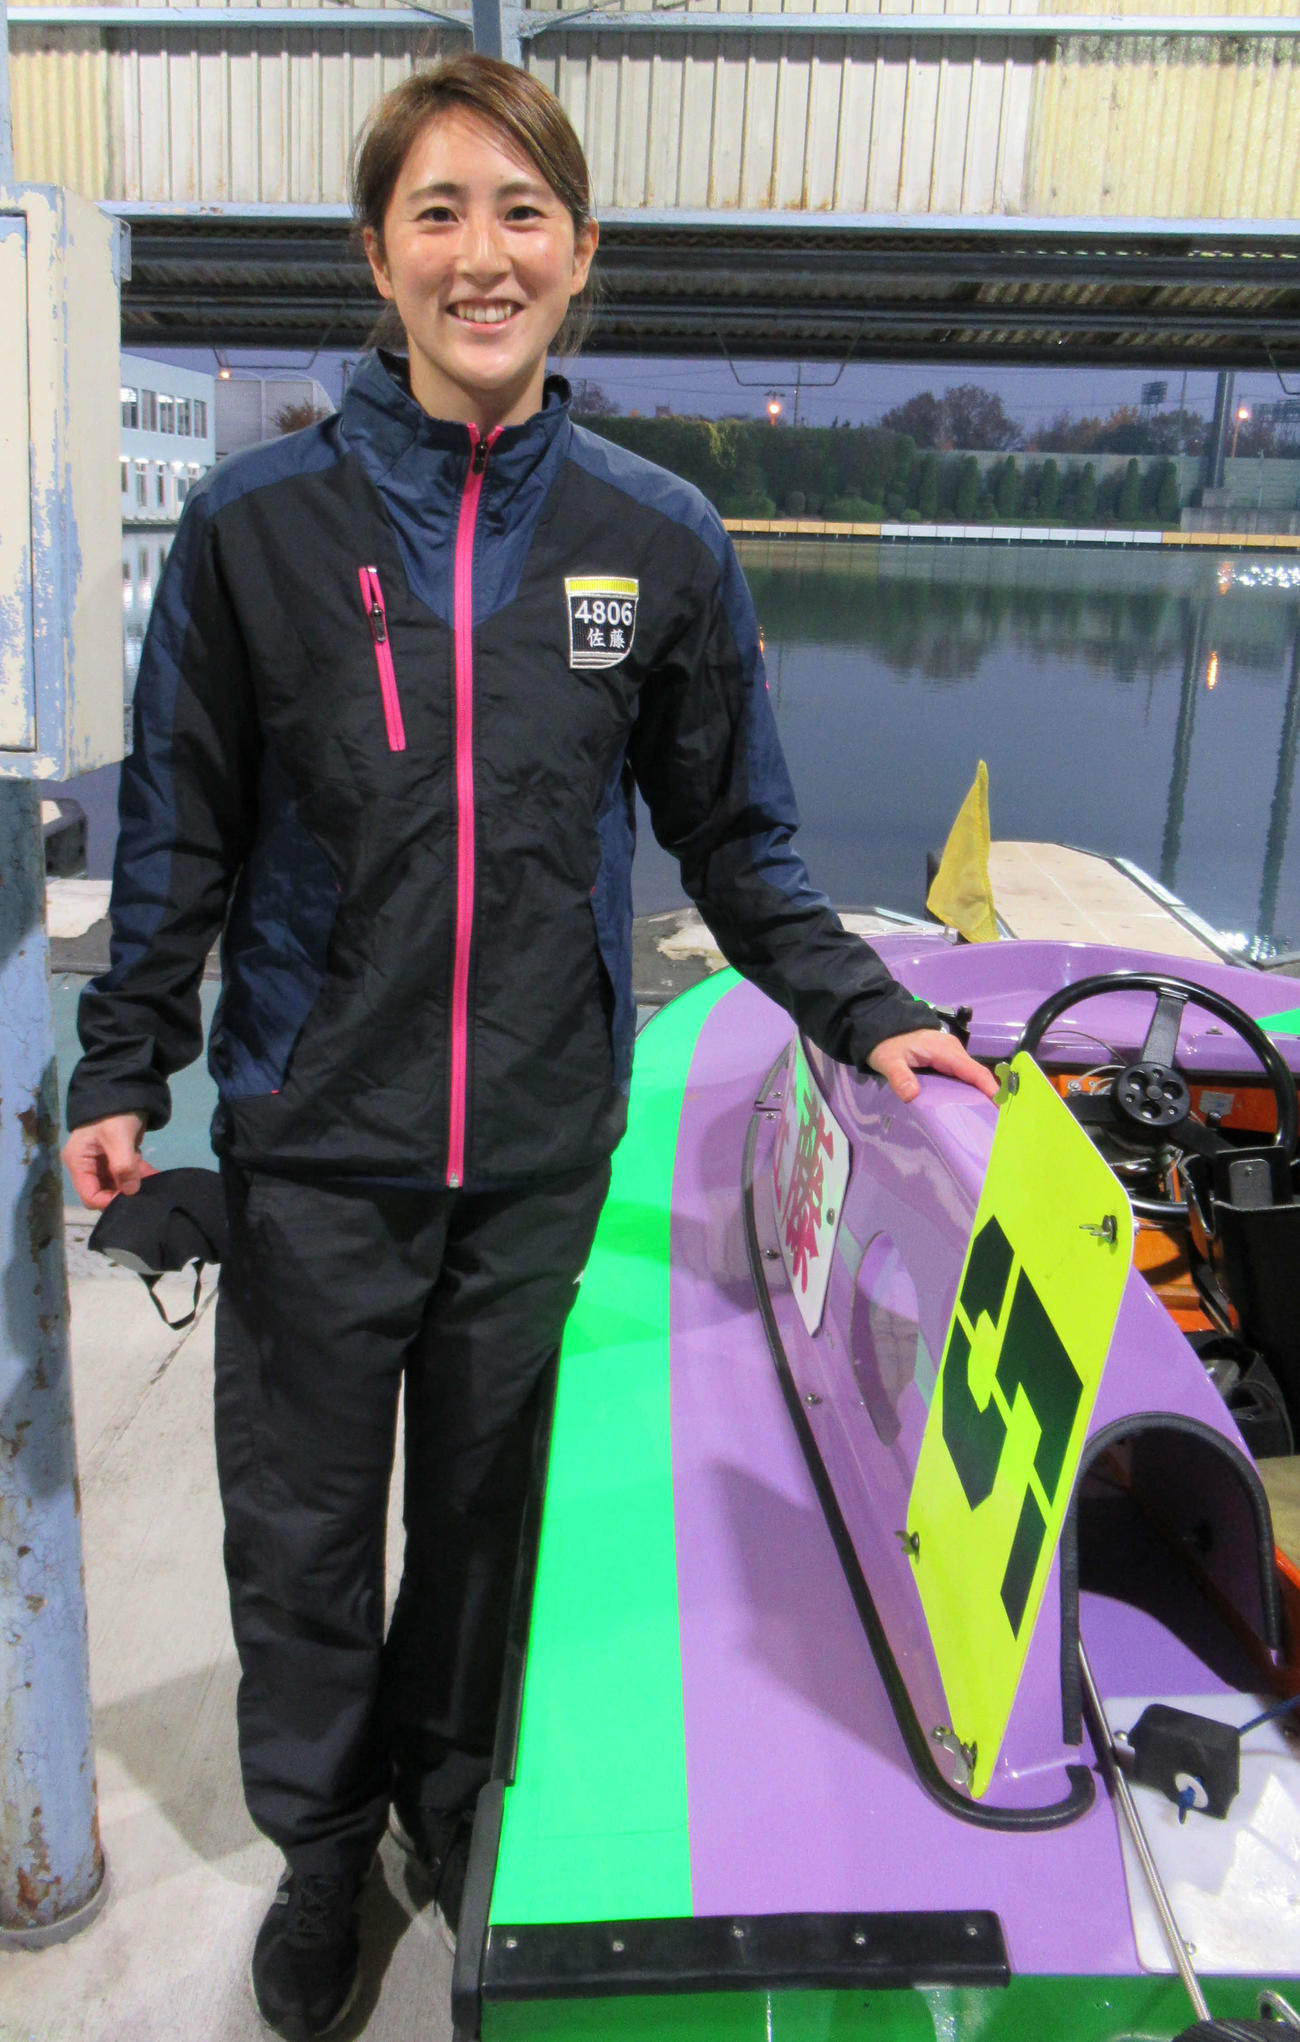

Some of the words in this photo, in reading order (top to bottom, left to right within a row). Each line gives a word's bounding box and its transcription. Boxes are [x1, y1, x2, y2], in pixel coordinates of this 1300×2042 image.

[574, 600, 633, 626] 4806
[587, 628, 626, 649] 佐藤
[942, 1214, 1084, 1642] 5
